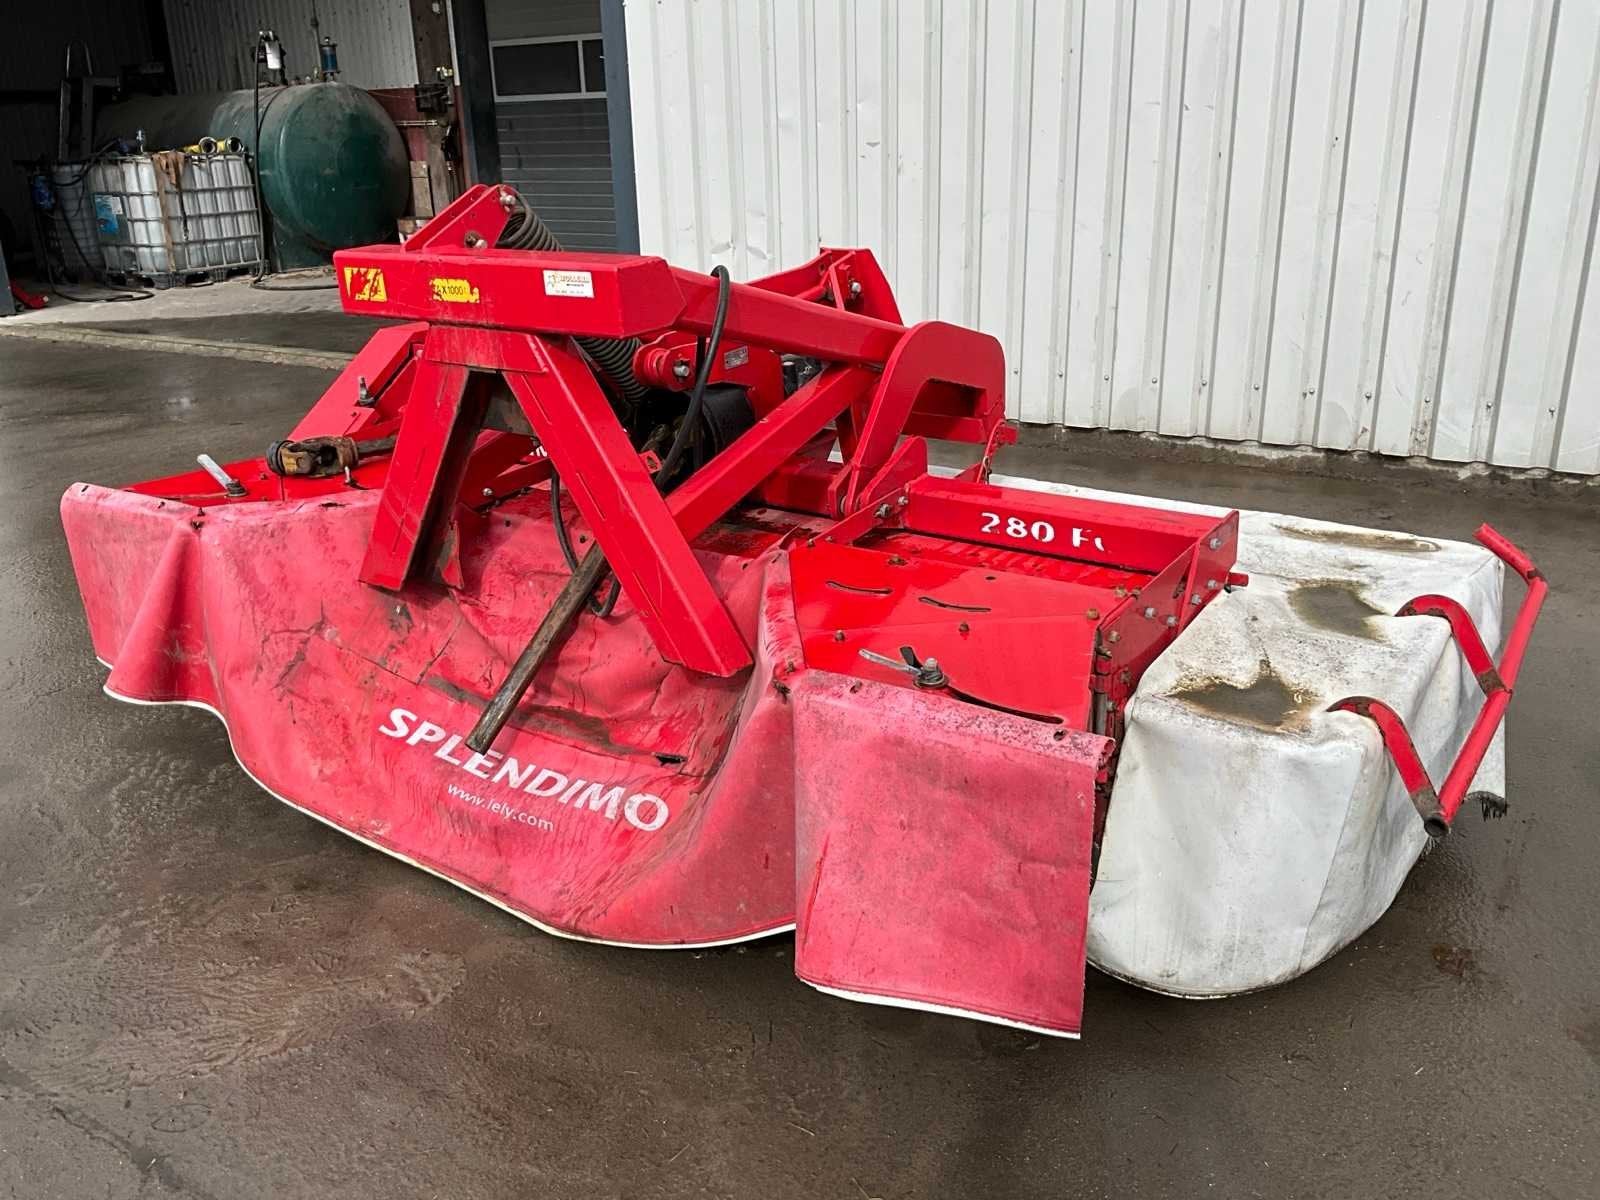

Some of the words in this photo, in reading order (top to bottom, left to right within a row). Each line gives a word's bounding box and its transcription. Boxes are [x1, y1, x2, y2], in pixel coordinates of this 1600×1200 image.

[980, 512, 1055, 543] 280
[378, 708, 670, 832] SPLENDIMO
[447, 783, 555, 833] www.lely.com
